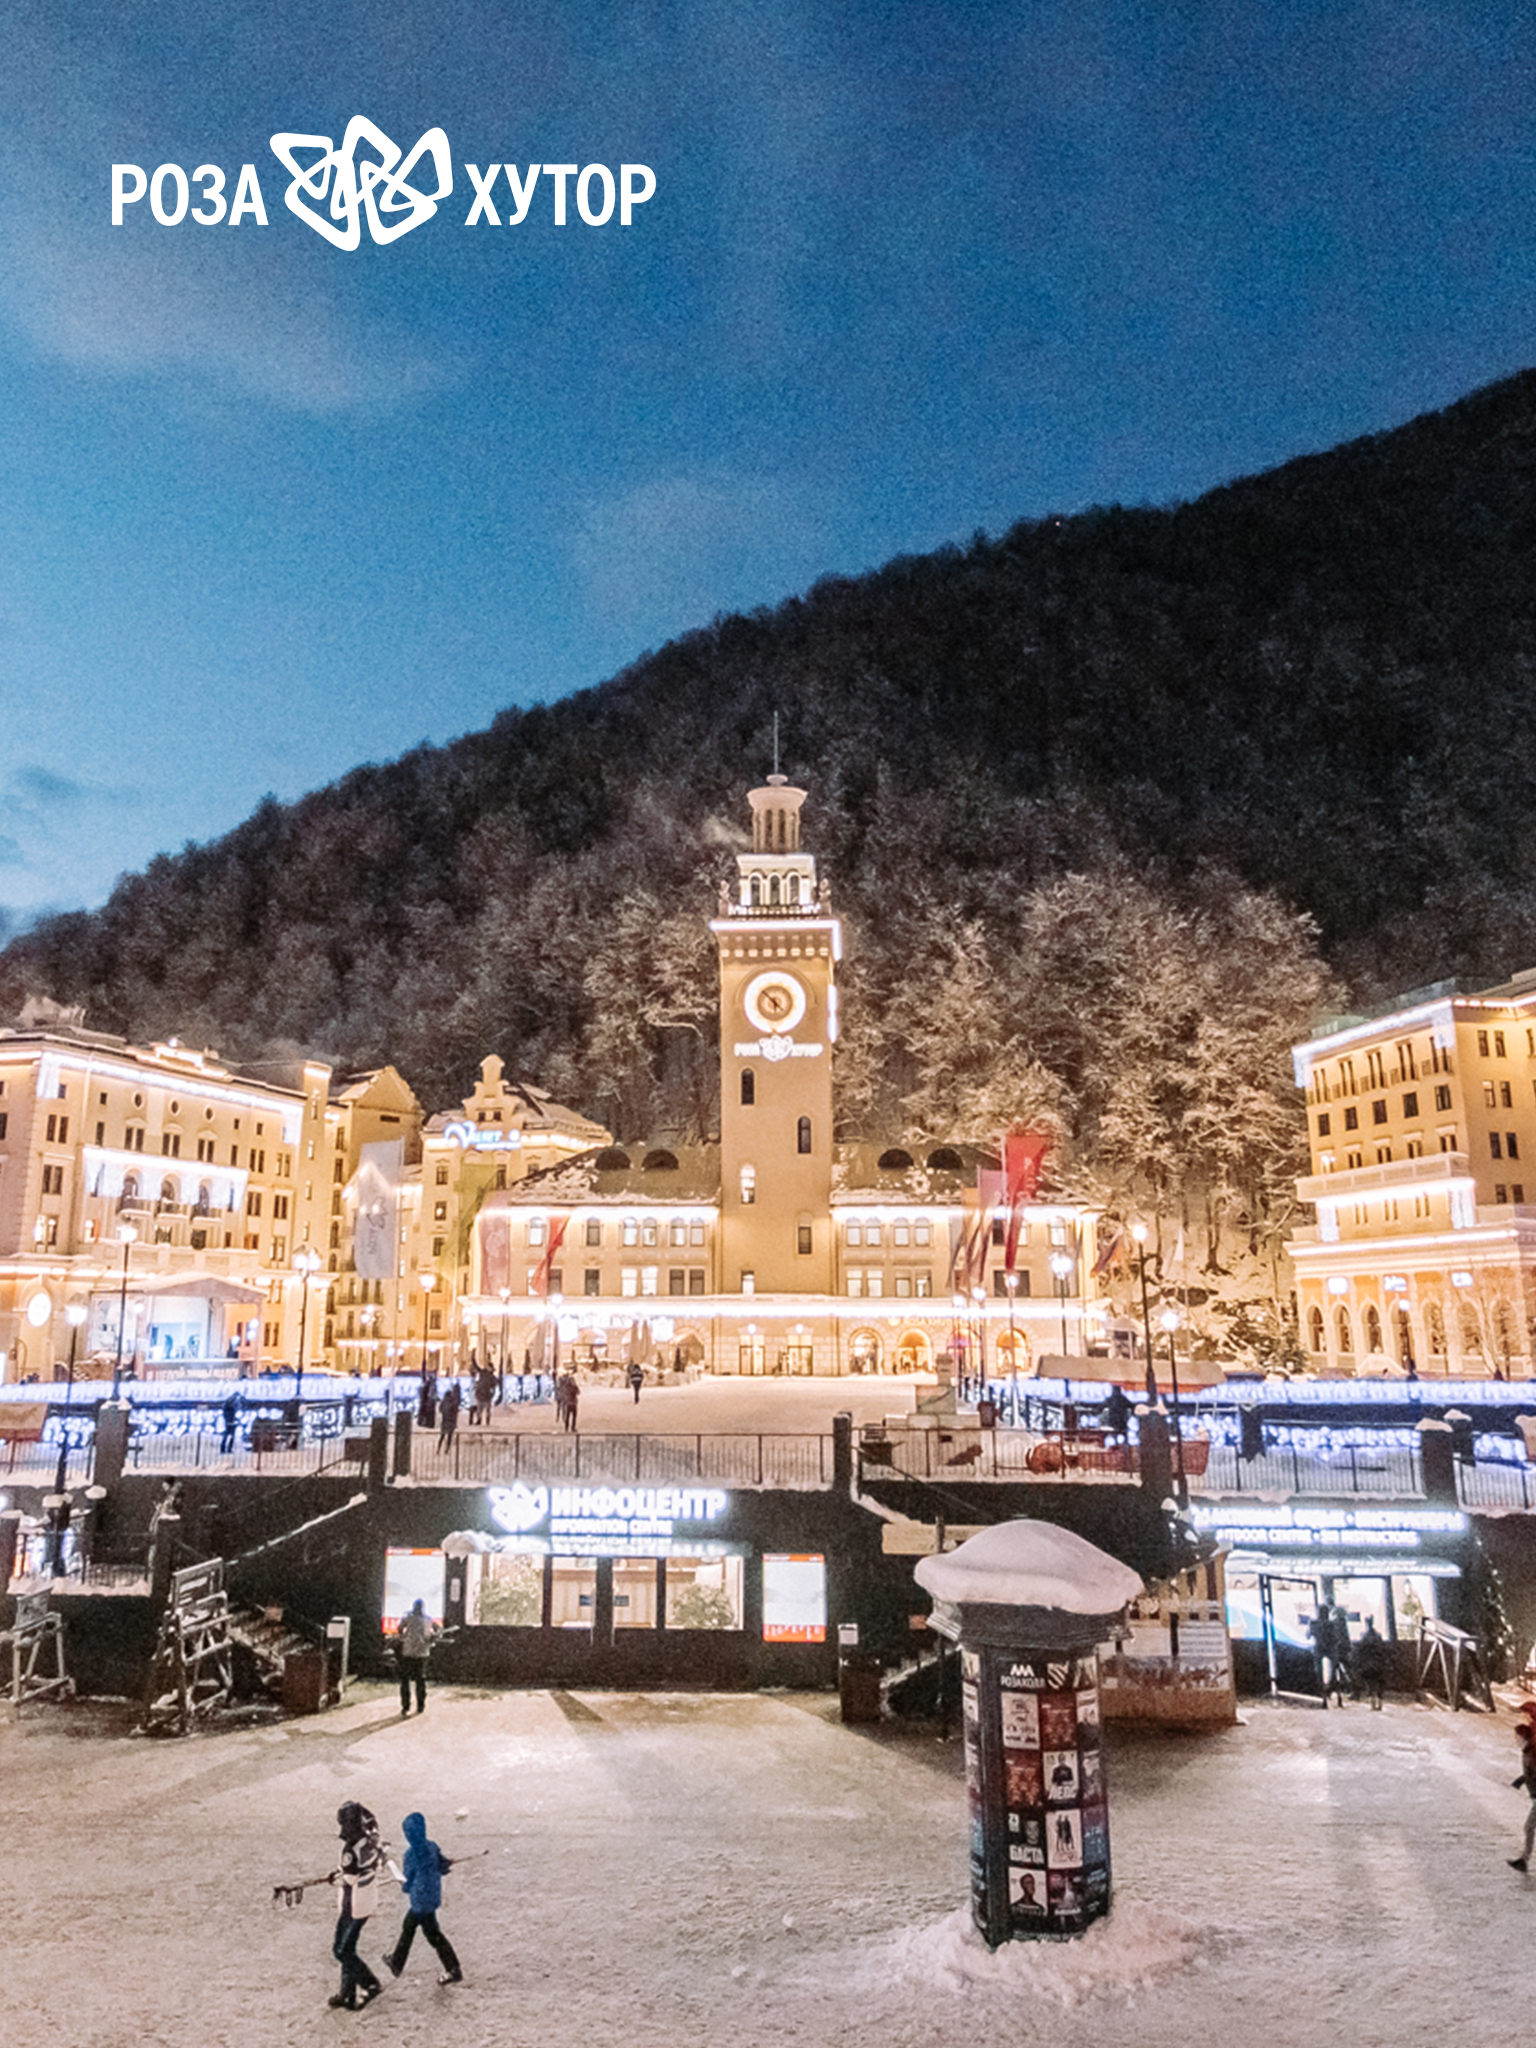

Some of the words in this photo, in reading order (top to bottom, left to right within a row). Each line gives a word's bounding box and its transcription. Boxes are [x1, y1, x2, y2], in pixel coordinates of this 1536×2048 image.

[551, 1487, 727, 1520] ИНФОЦЕНТР
[551, 1518, 628, 1533] INFORMATION
[630, 1520, 673, 1535] CENTRE
